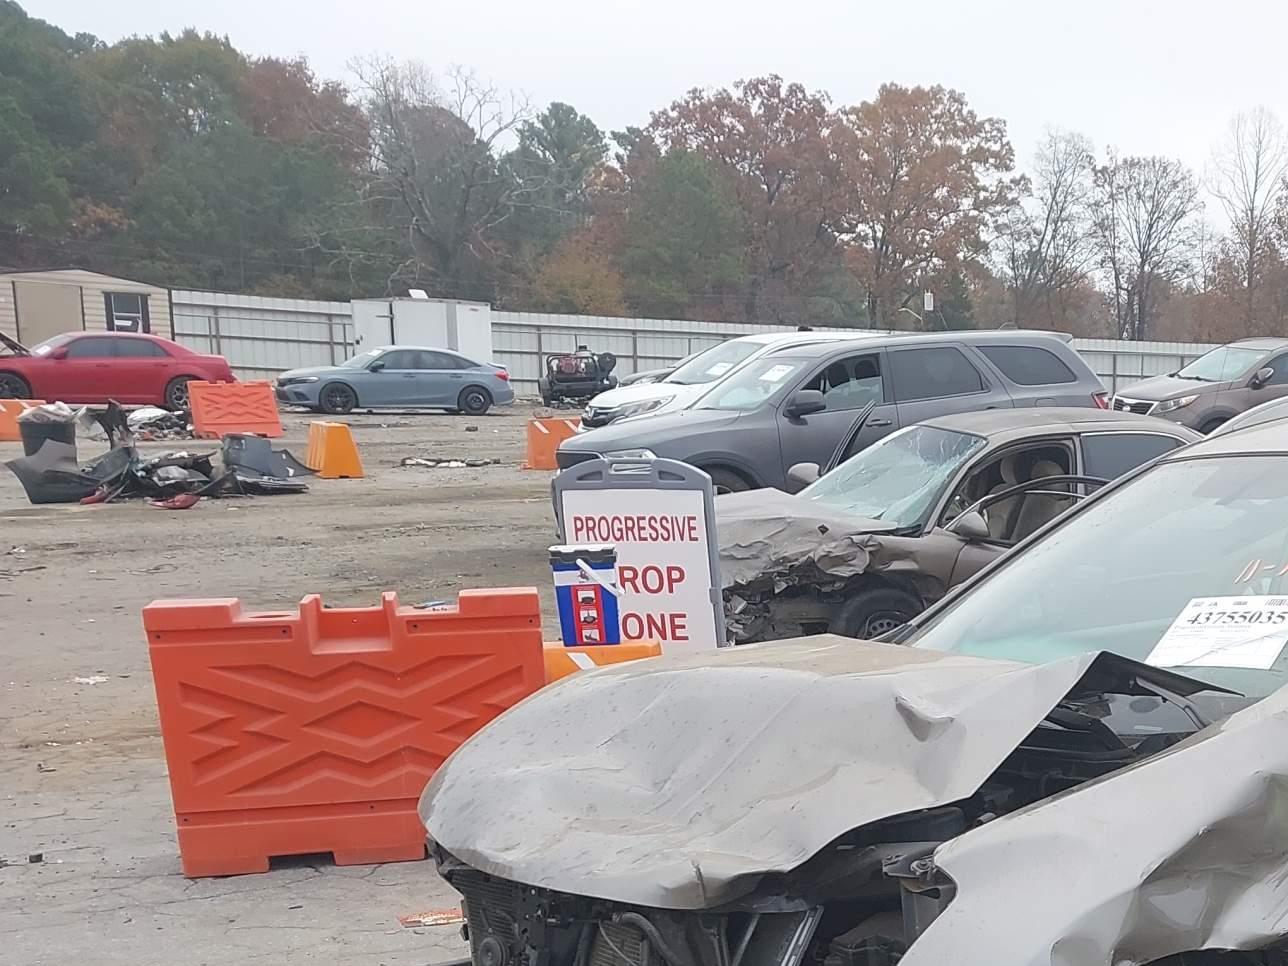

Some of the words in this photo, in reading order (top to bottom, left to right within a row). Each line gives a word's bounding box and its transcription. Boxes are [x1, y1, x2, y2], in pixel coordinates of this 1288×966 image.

[573, 516, 699, 542] PROGRESSIVE
[619, 566, 685, 594] ROP
[621, 612, 689, 641] ONE
[1187, 611, 1288, 625] 43755035
